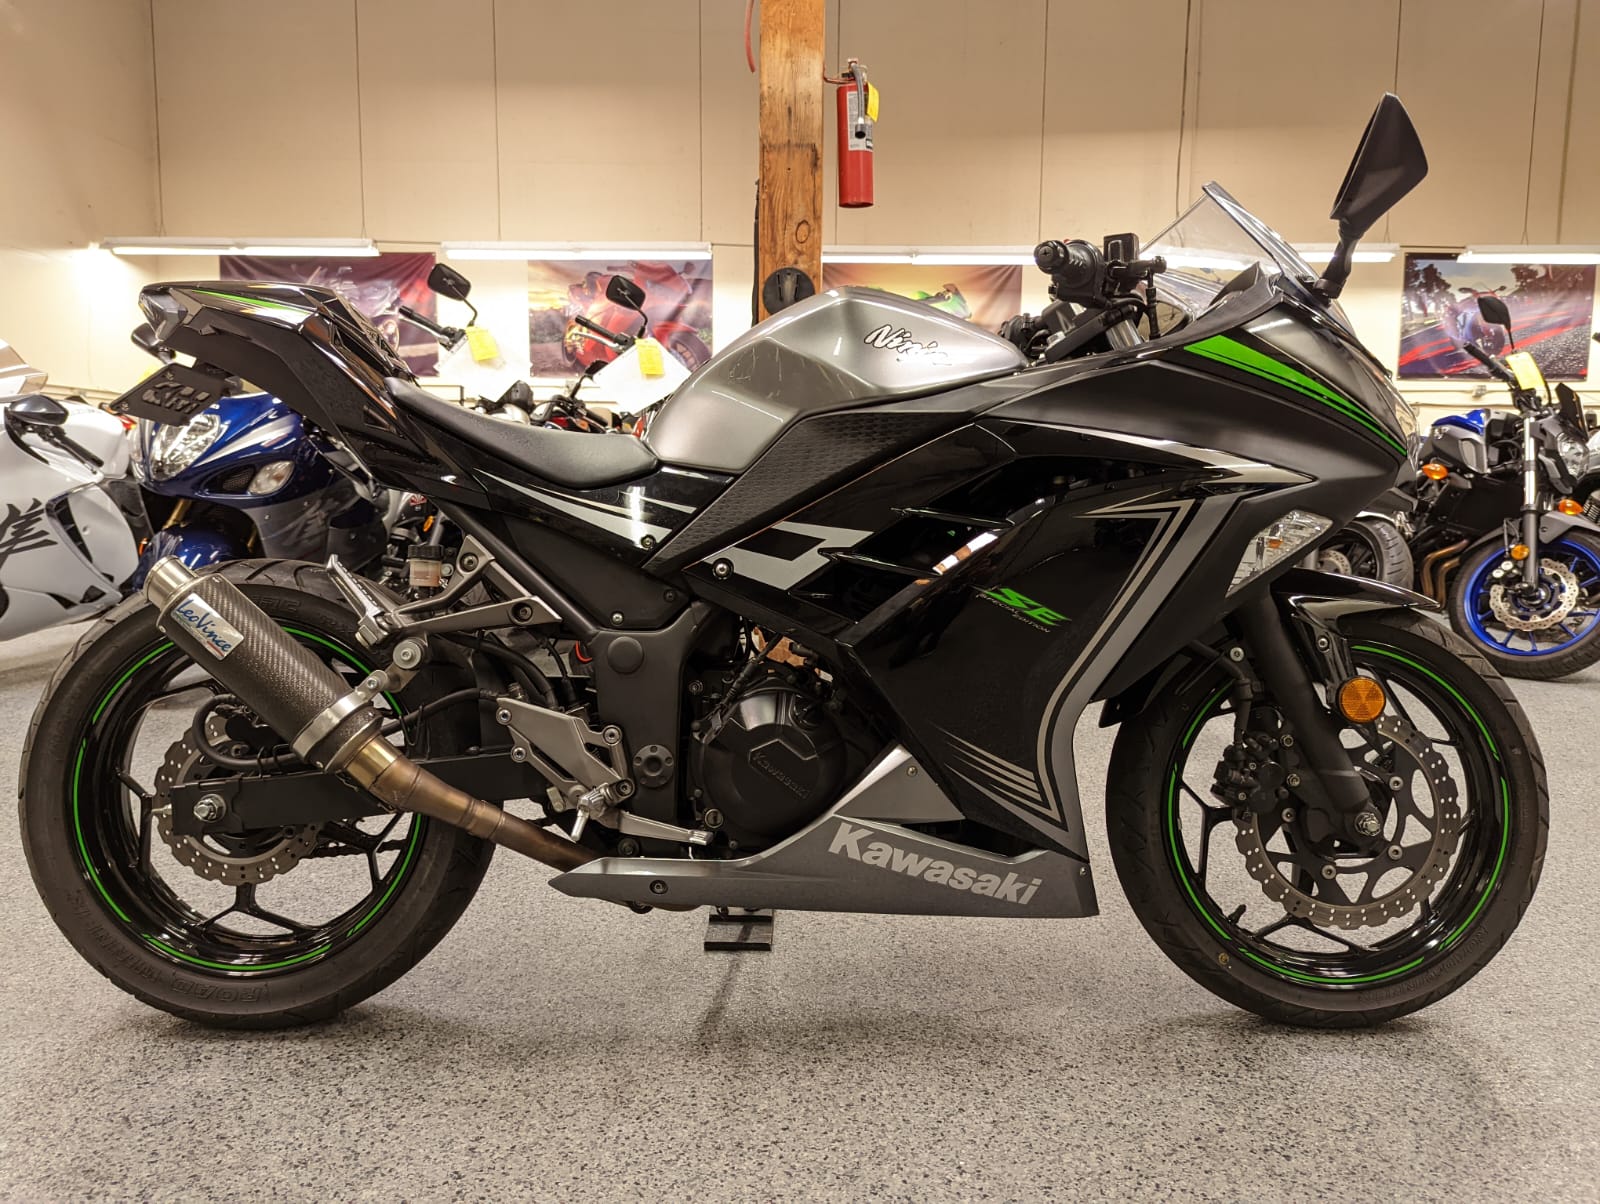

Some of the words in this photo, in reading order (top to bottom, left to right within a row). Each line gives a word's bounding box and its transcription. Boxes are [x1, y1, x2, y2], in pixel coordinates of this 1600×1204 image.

[175, 599, 232, 652] LeoVince
[752, 752, 811, 800] Kawasaki
[827, 822, 1043, 905] Kawasaki
